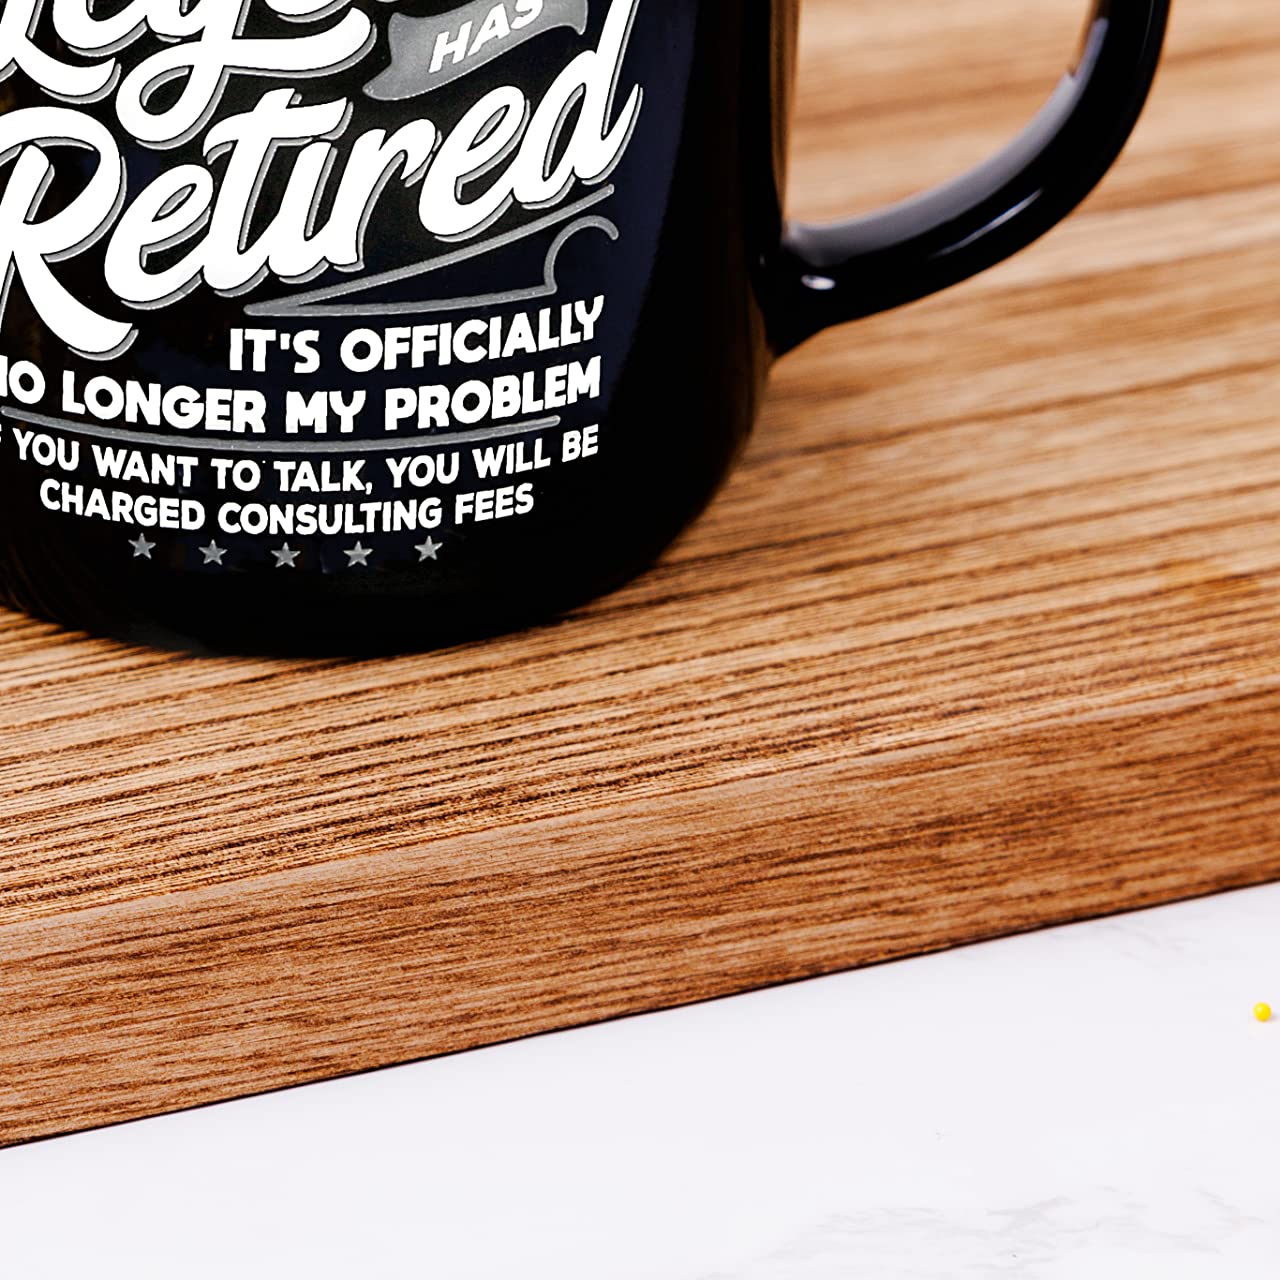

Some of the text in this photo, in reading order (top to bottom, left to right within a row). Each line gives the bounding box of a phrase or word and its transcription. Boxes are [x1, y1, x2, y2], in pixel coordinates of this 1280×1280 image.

[229, 294, 605, 374] IT'S OFFICIALLY
[61, 369, 267, 434] LONGER
[285, 389, 367, 434] MY
[384, 355, 602, 431] PROBLEM
[12, 427, 80, 472] YOU
[91, 444, 199, 488] WANT
[210, 457, 261, 492] TO
[272, 459, 373, 496] TALK,
[385, 451, 460, 489] YOU
[471, 437, 552, 479] WILL
[561, 423, 599, 463] BE
[39, 478, 535, 536] CHARGED CONSULTING FEES
